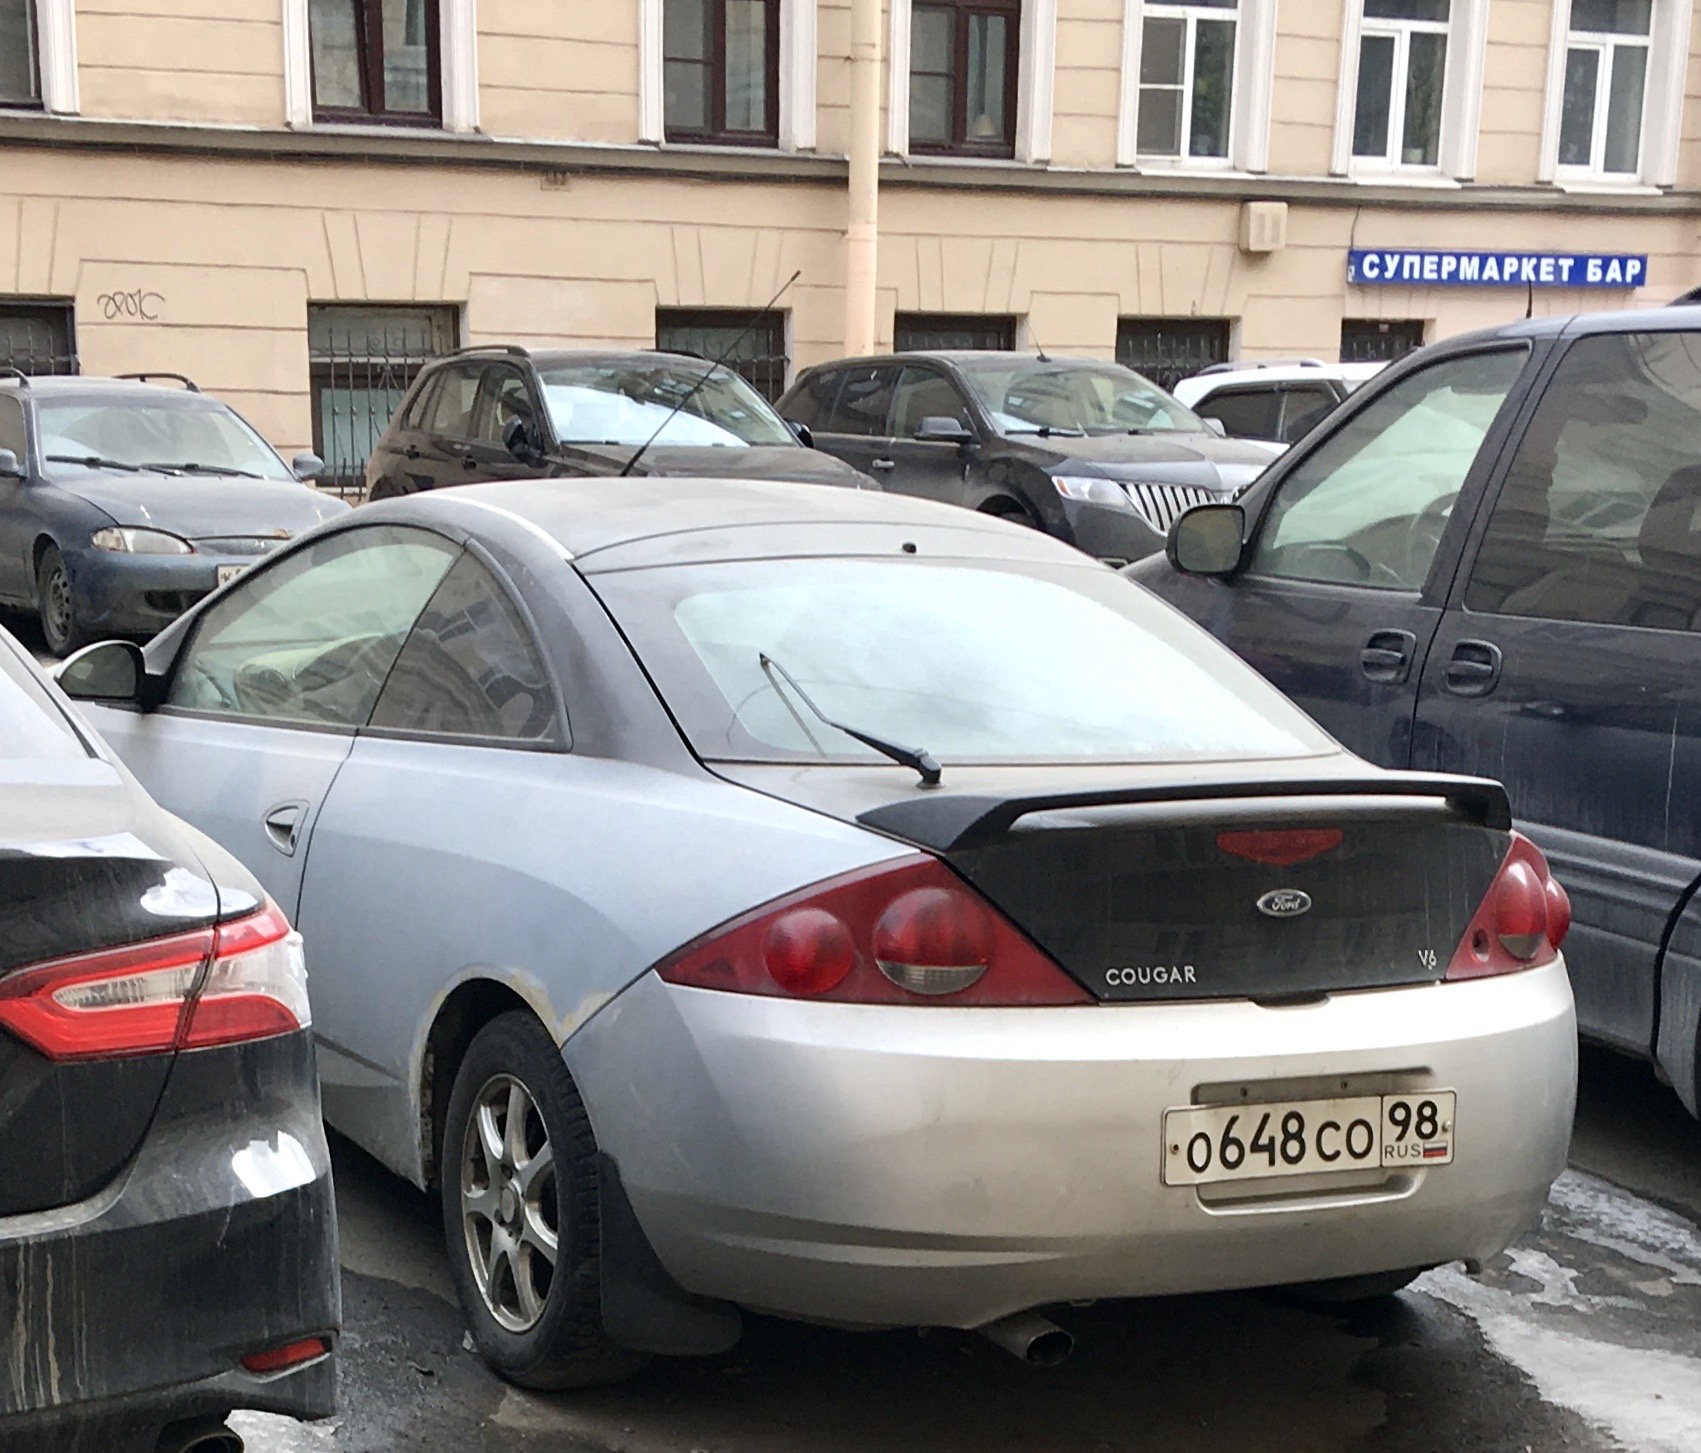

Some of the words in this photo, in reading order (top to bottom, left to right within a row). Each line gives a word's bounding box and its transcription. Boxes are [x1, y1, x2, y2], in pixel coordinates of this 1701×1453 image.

[1362, 253, 1574, 282] СУПЕРМАРКЕТ
[1586, 258, 1641, 282] БАР
[1271, 894, 1300, 911] Ford
[1418, 949, 1437, 968] V6
[1105, 965, 1197, 986] COUGAR
[1388, 1100, 1439, 1142] 98
[1384, 1143, 1421, 1160] RUS
